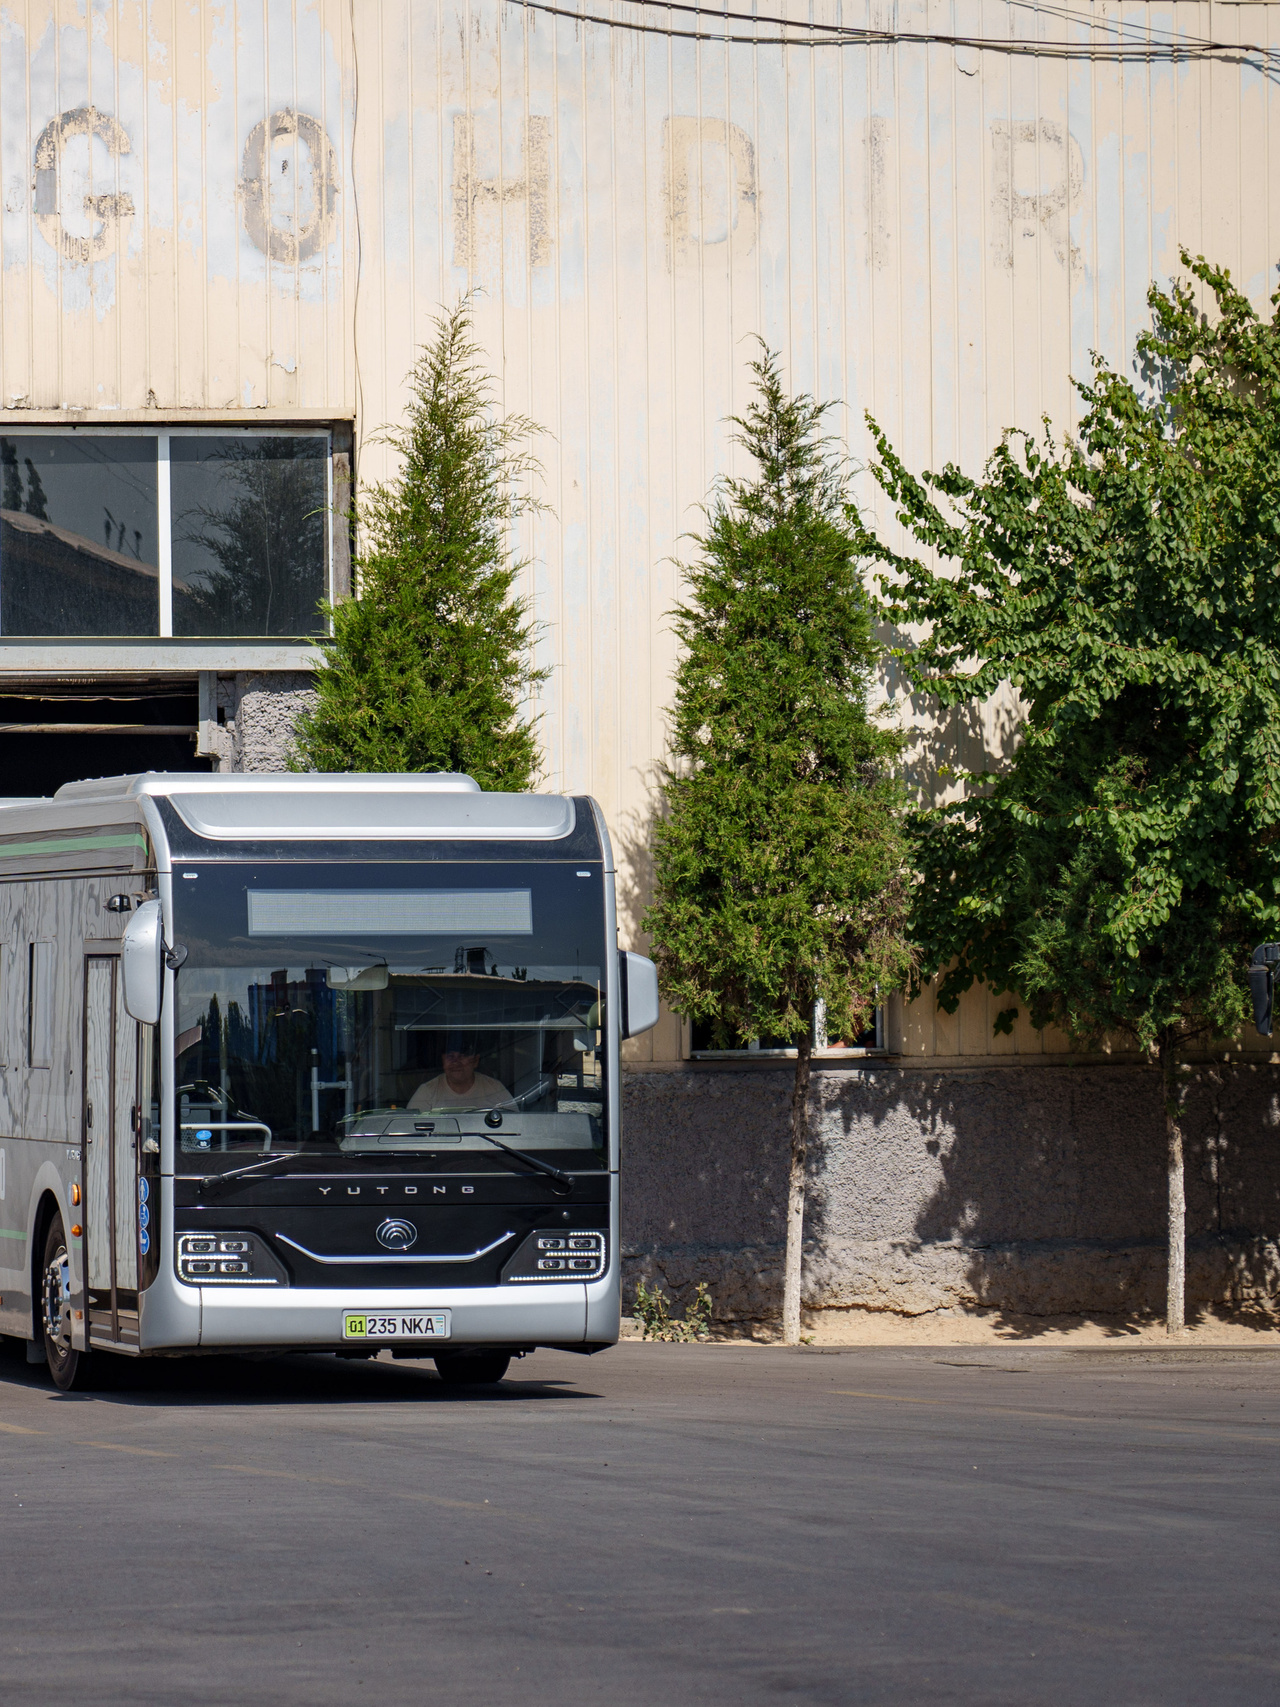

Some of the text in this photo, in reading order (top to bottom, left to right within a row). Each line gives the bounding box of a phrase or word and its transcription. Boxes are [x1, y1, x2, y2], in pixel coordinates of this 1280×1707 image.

[318, 1186, 475, 1195] YUTONG
[349, 1317, 435, 1334] 01 235 NKA
